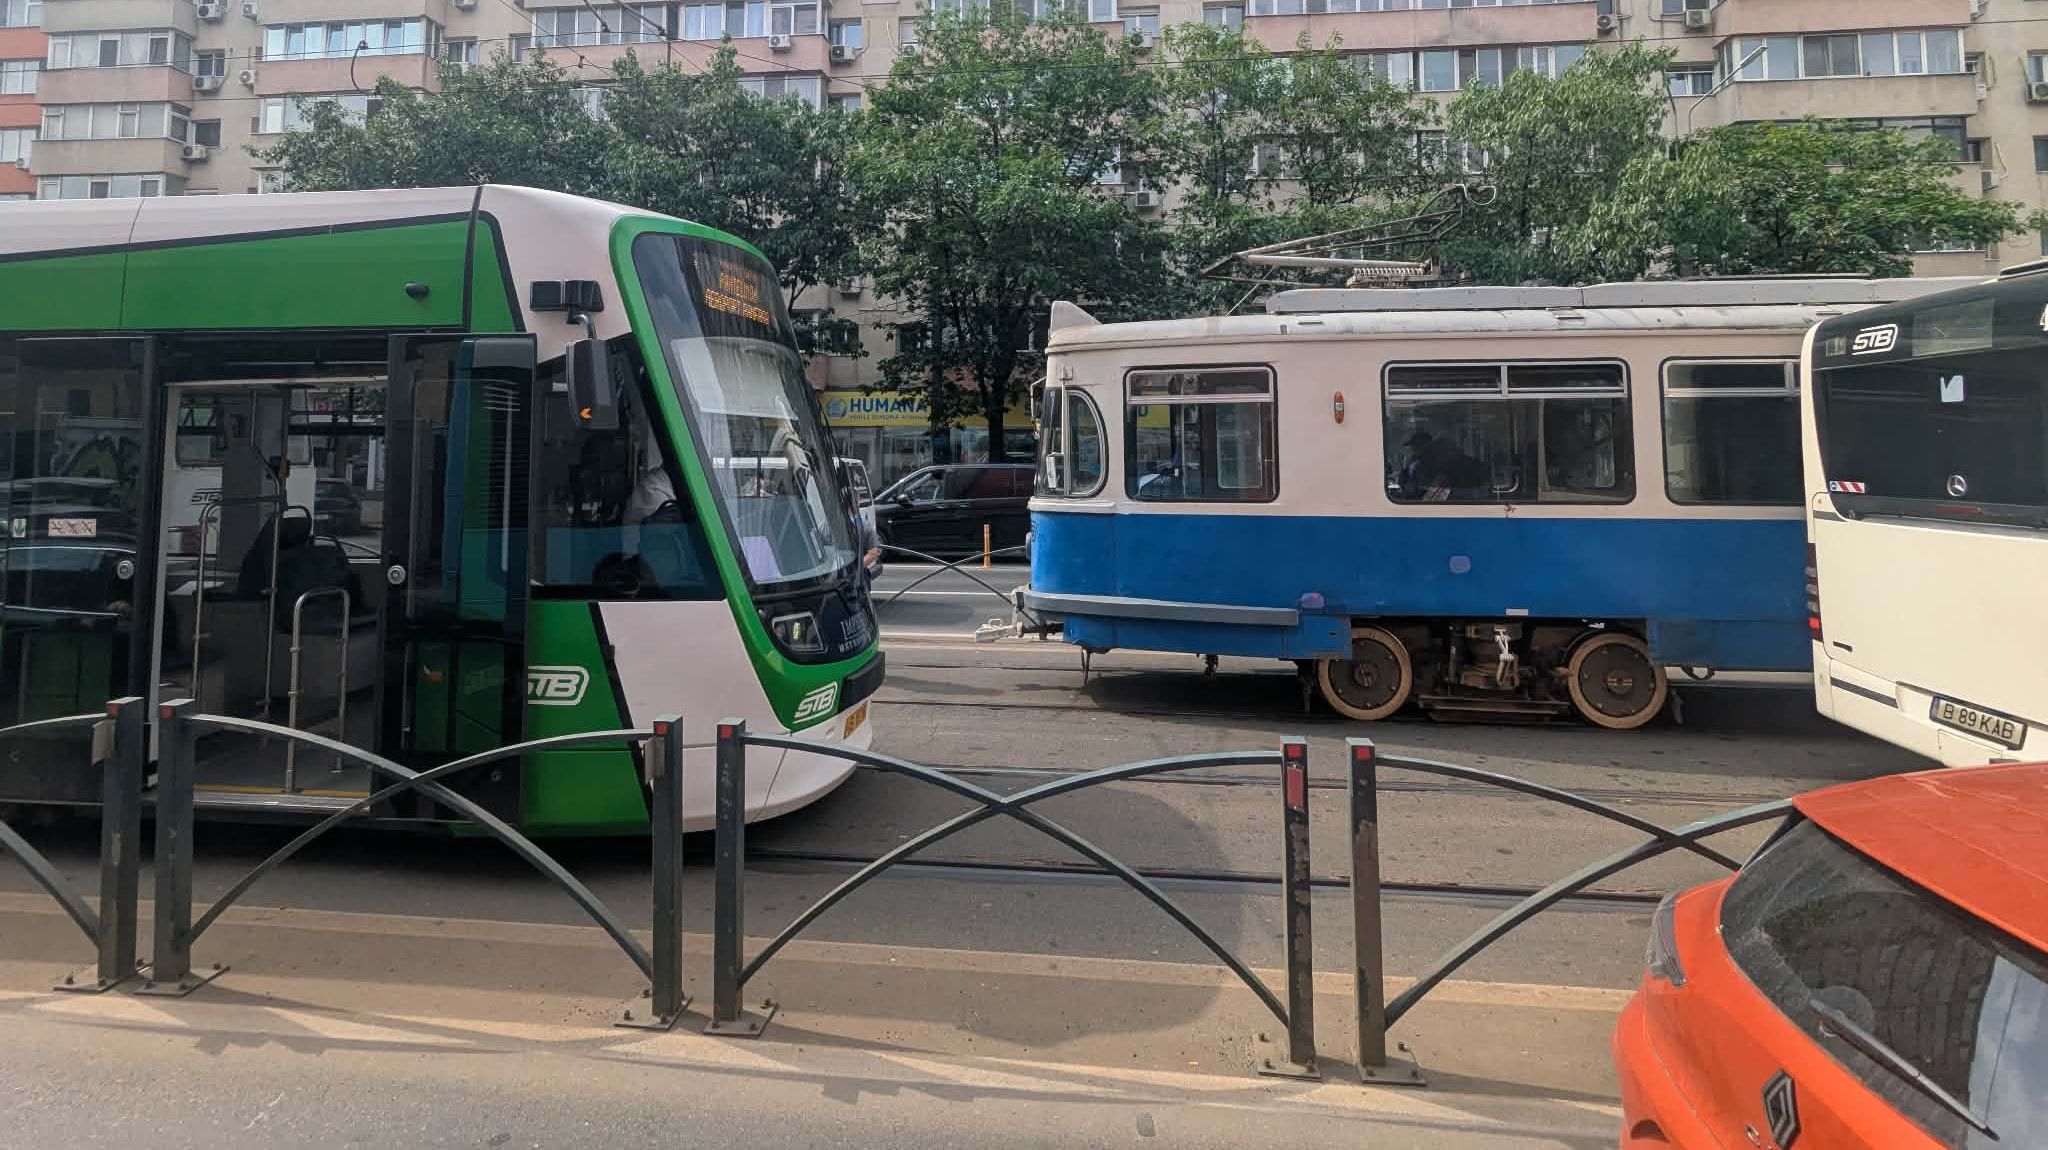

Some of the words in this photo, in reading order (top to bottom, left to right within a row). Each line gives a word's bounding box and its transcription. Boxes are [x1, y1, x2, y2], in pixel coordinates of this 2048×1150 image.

[1853, 329, 1893, 351] STB
[850, 397, 928, 413] HUMANA
[528, 673, 580, 697] TB
[794, 688, 835, 719] STB
[1943, 702, 1955, 719] B
[1958, 708, 1977, 727] 89
[1979, 714, 2015, 739] KAB
